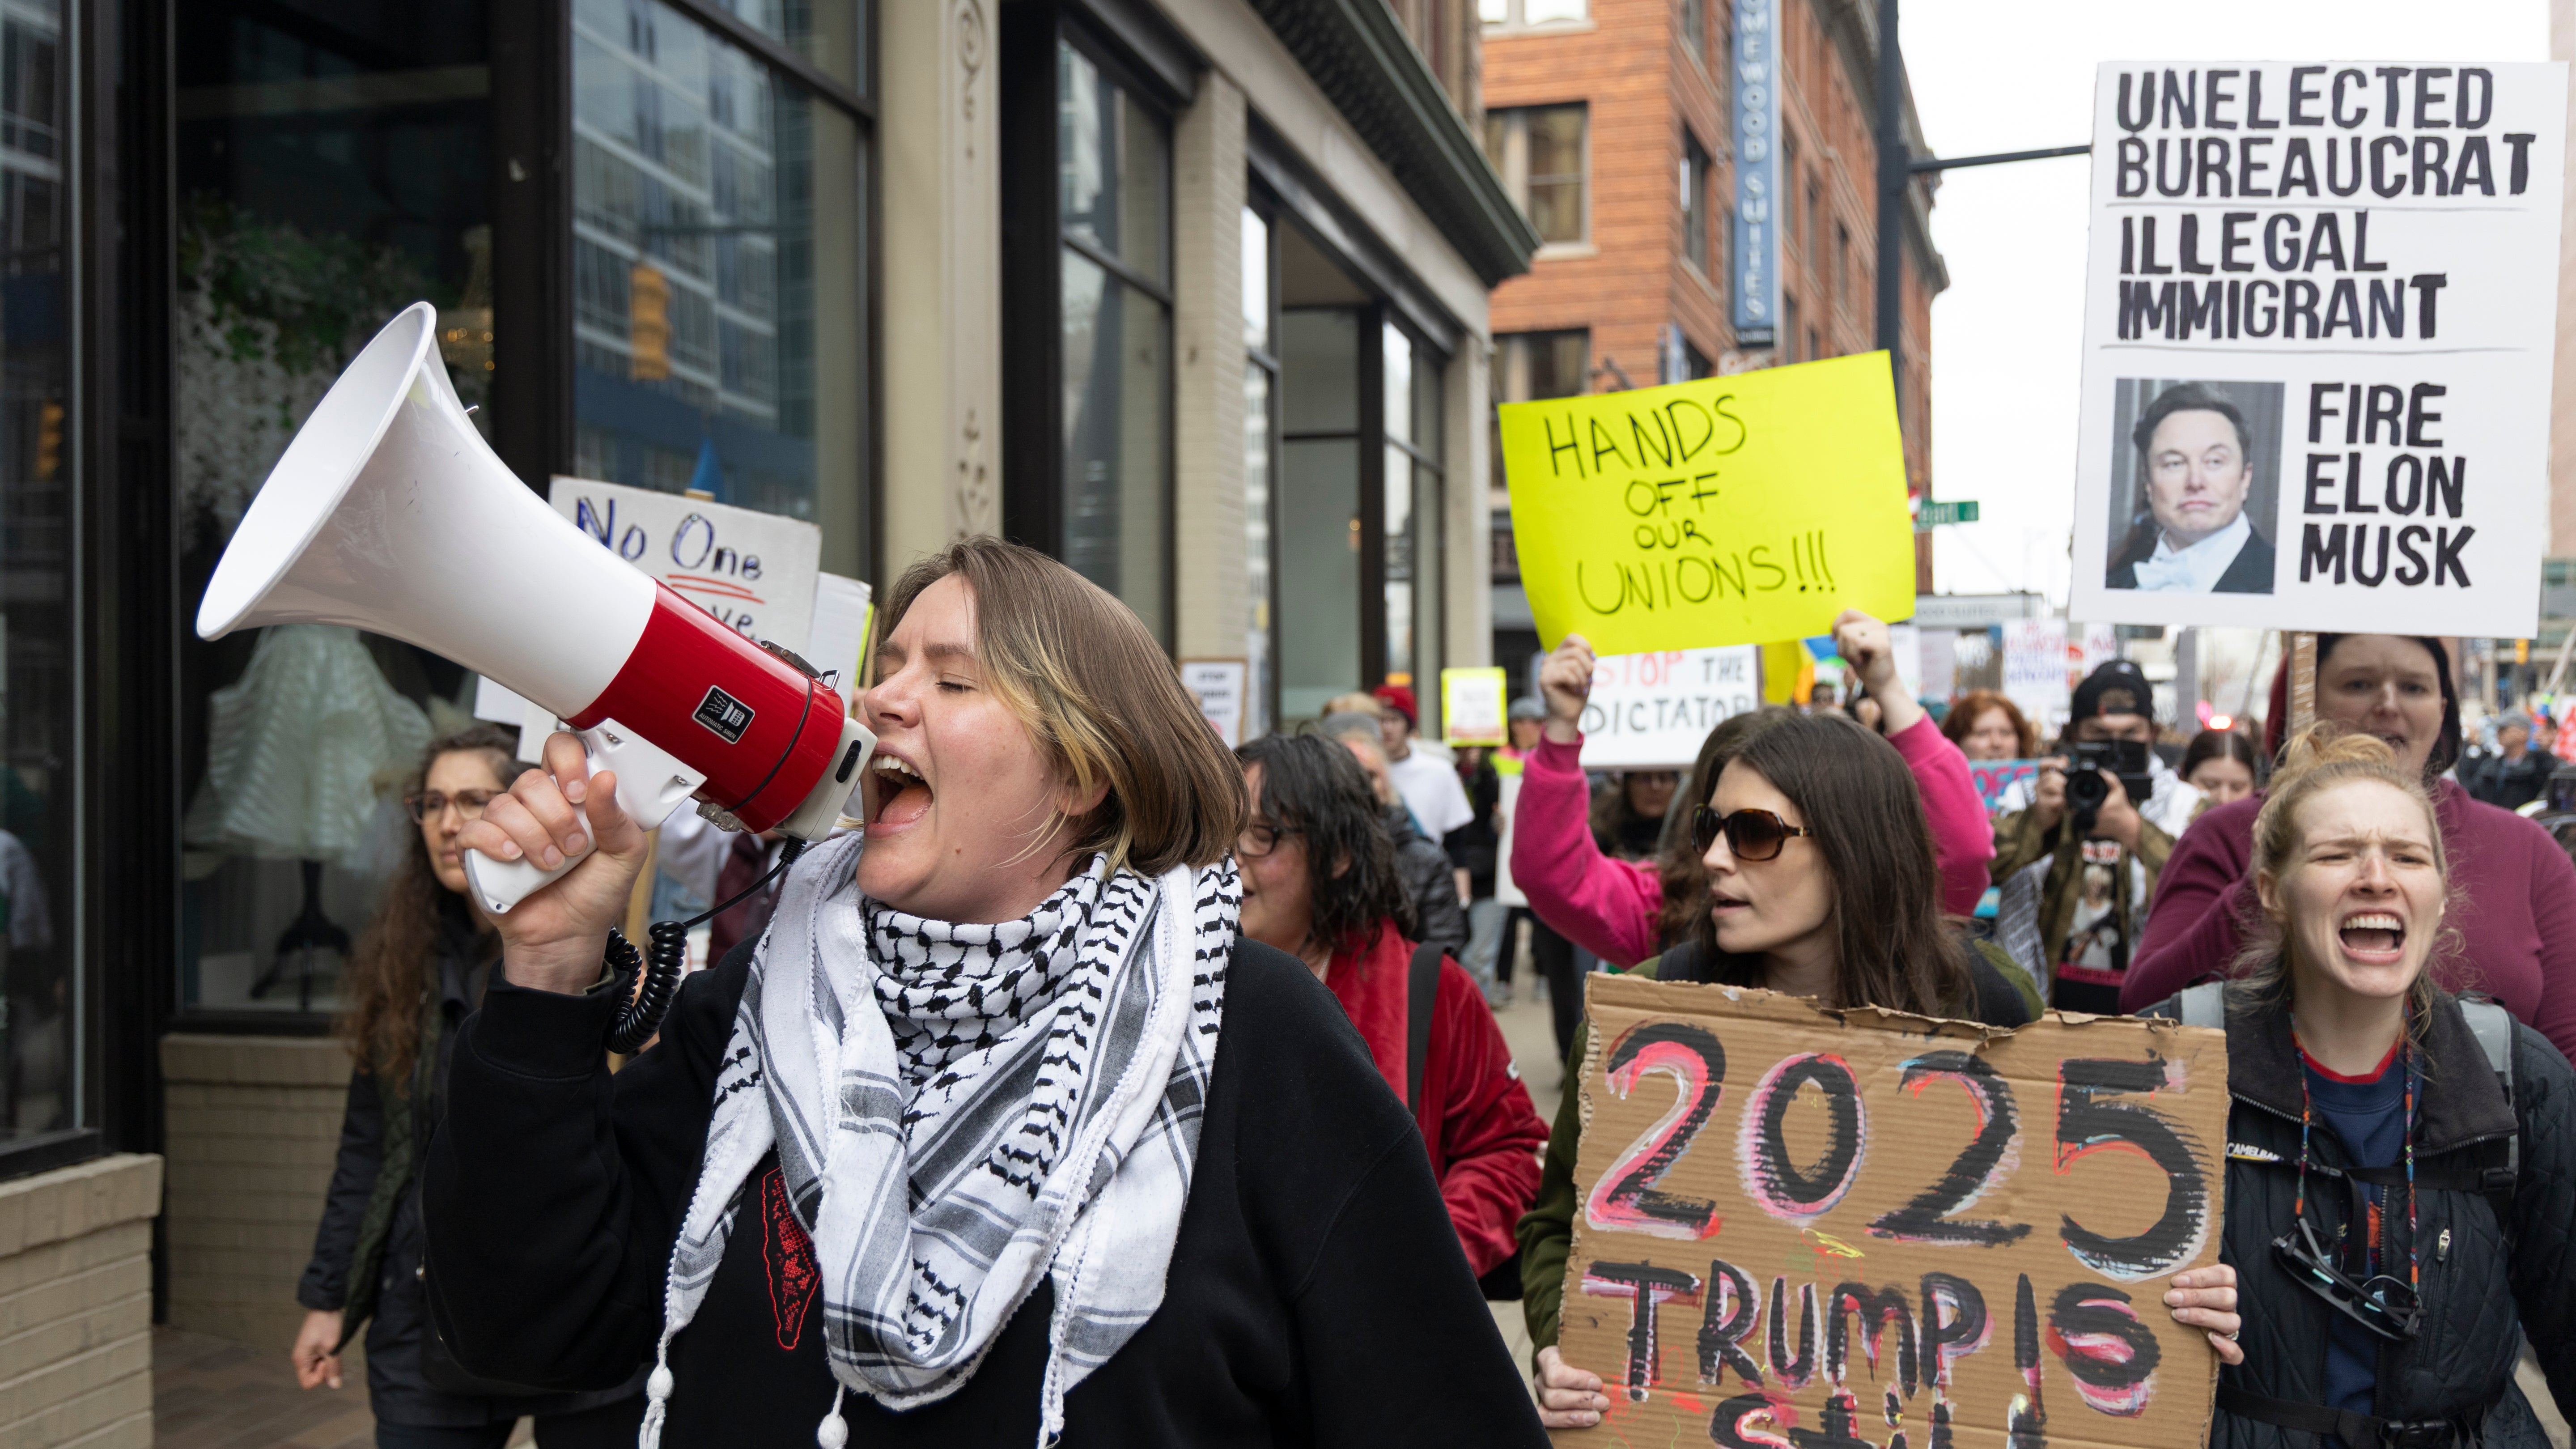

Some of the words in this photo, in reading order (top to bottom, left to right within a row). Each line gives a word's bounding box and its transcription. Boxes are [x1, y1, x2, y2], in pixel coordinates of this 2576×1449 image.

[2117, 66, 2493, 132] UNELECTED
[2116, 134, 2536, 198] BUREAUCRAT
[2120, 208, 2388, 275] ILLEGAL
[2118, 273, 2447, 340] IMMIGRANT
[1545, 395, 1745, 478] HANDS
[2308, 382, 2446, 446] FIRE
[1625, 472, 1718, 517] OFF
[2303, 453, 2466, 518] ELON
[576, 497, 647, 561] No
[671, 513, 762, 580] One
[1634, 519, 1713, 550] OUR
[2299, 523, 2475, 587] MUSK
[1576, 529, 1836, 615] UNIONS!!!
[1592, 652, 1684, 687] STOP
[1703, 655, 1744, 682] THE
[699, 713, 723, 731] AUTOMATIC
[723, 729, 736, 739] SIREN
[1585, 1021, 2212, 1281] 2025
[1580, 1258, 1995, 1403] TRUMP
[2014, 1273, 2161, 1423] IS
